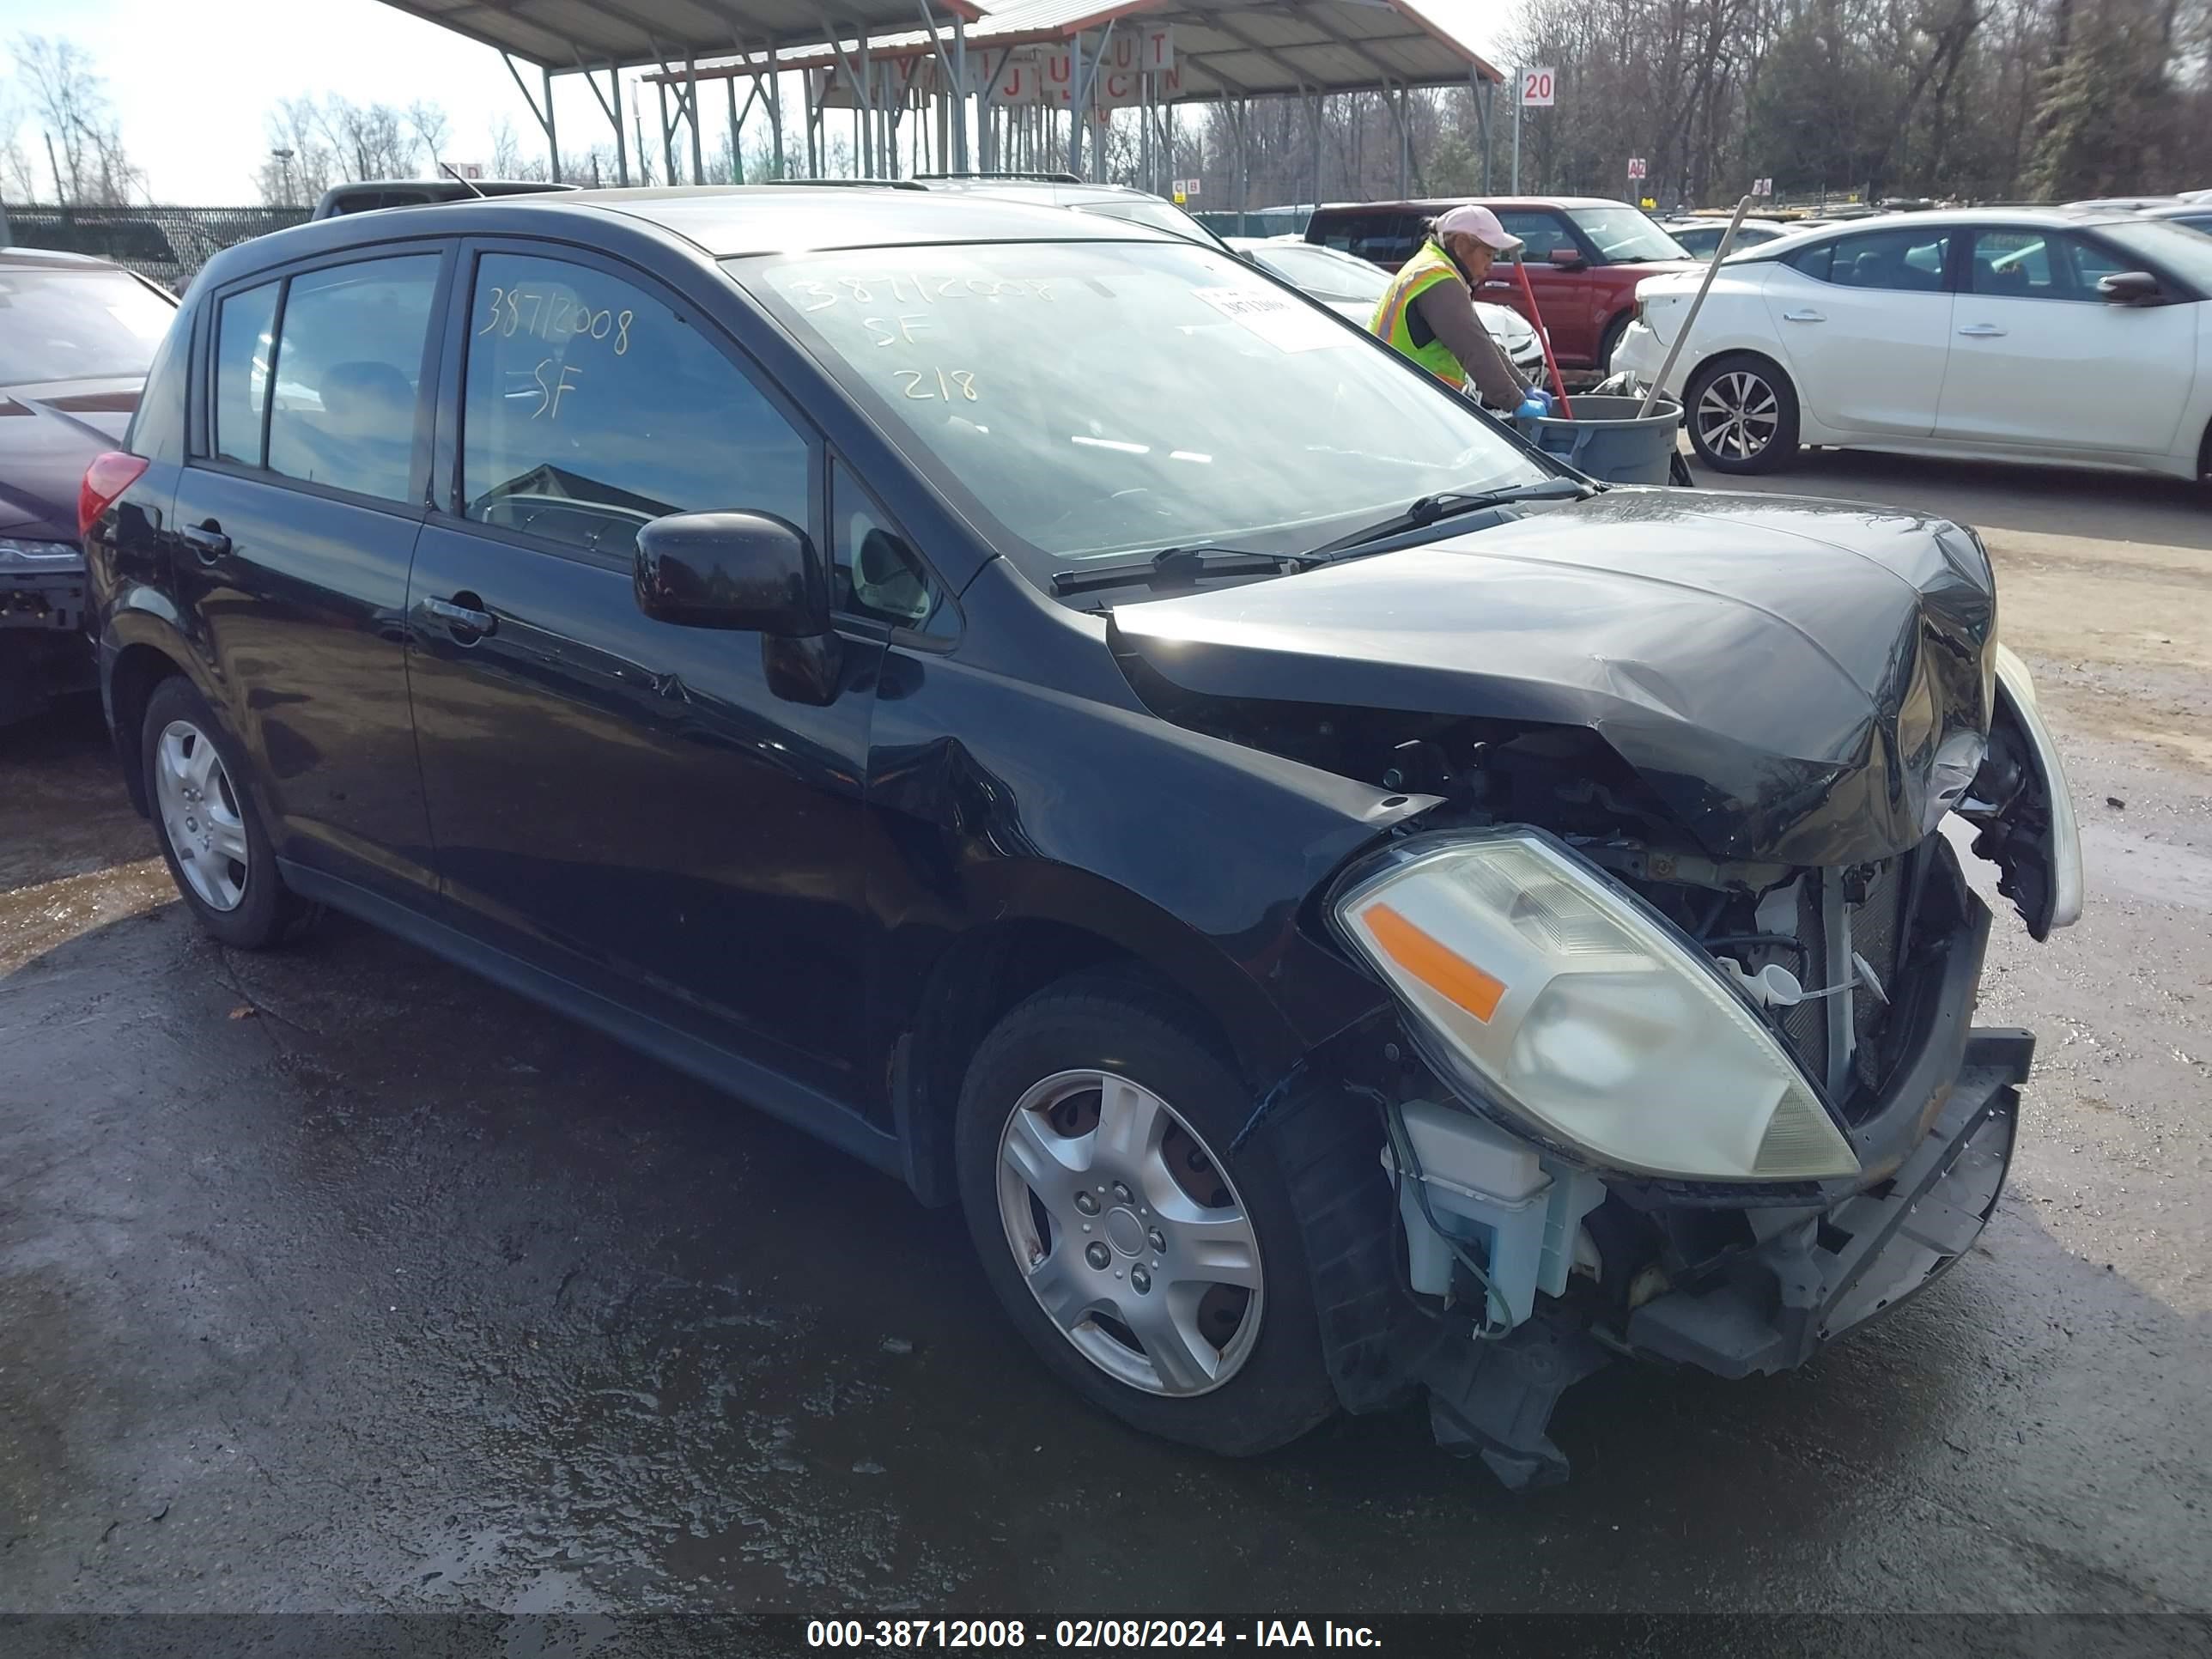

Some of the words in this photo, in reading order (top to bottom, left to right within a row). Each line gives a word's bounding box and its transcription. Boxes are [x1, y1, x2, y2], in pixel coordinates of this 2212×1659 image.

[1152, 33, 1165, 64] T
[1004, 68, 1020, 96] J
[1049, 56, 1071, 83] U
[1107, 75, 1127, 98] C
[1524, 74, 1552, 99] 20
[862, 313, 933, 347] SF
[531, 358, 584, 420] SF
